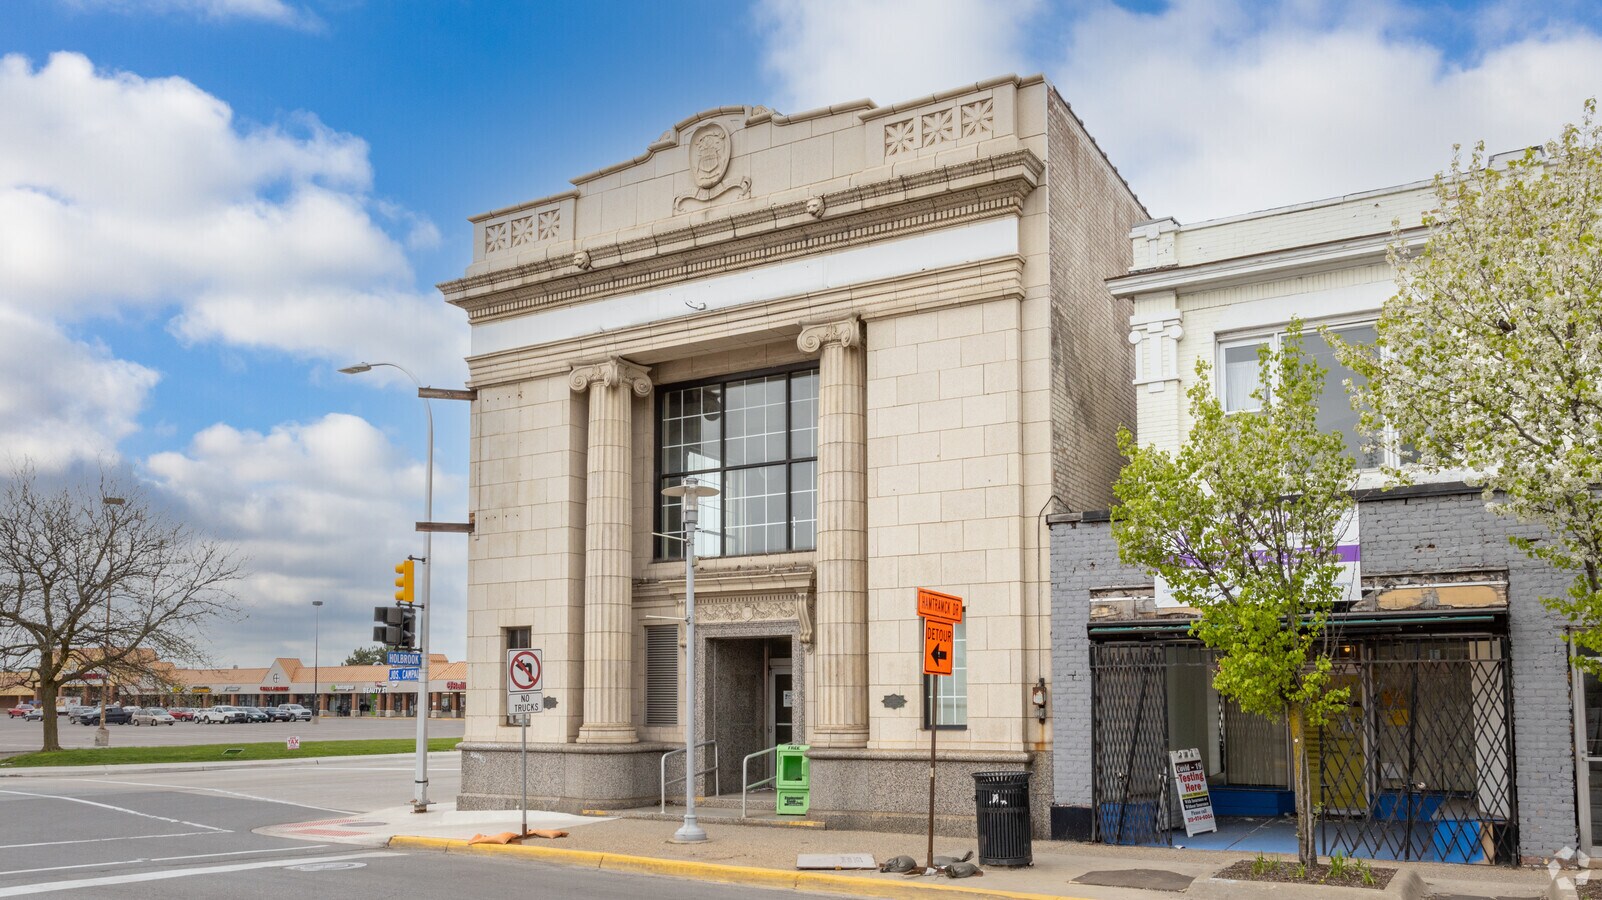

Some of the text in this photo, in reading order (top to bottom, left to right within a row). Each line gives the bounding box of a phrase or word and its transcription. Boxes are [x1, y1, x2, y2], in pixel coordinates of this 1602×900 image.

[921, 595, 959, 616] HAMTRAMCK DR
[927, 627, 952, 642] DETOUR
[389, 653, 420, 665] HOLBROOK
[389, 669, 401, 680] JOS.
[520, 694, 530, 702] NO
[514, 703, 539, 713] TRUCKS
[1176, 764, 1190, 773] Covid
[1178, 771, 1204, 783] Testing
[1185, 783, 1202, 792] Here
